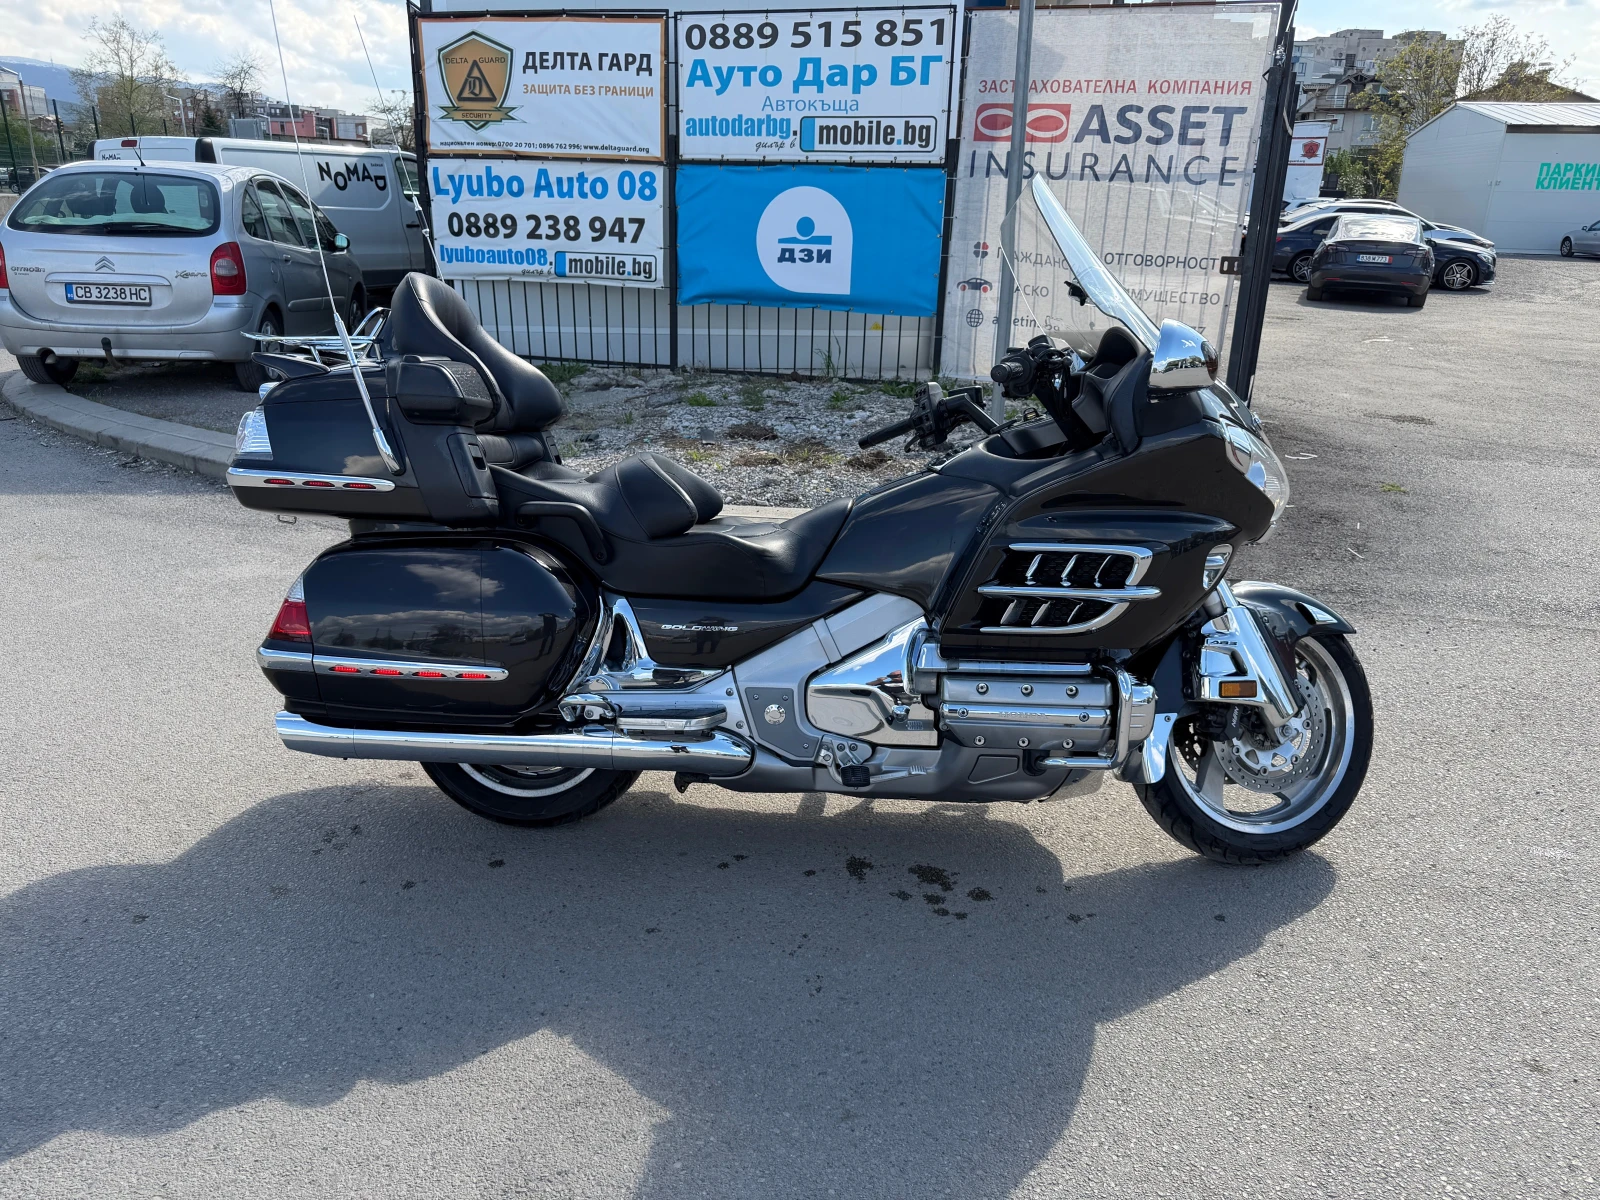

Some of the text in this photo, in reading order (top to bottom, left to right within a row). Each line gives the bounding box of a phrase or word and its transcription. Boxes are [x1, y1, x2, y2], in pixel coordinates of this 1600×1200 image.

[685, 18, 945, 50] 0889 515 851
[445, 56, 506, 65] DELTA GUARD
[522, 51, 653, 77] ДЕЛТА ГАРД
[685, 55, 943, 96] Ауто Дар БГ
[522, 83, 654, 99] ЗАЩИТА БЕЗ ГРАНИЦИ
[978, 79, 1252, 96] ЗАСТАХОВАТЕЛНА КОМПАНИЯ
[761, 95, 859, 114] Автокъща
[818, 120, 932, 149] mobile.bg
[1073, 104, 1248, 147] ASSET
[583, 144, 650, 153] www.deltaguard.org
[316, 161, 387, 192] NOMAD
[969, 149, 1240, 187] INSURANCE
[432, 165, 657, 205] Lyubo Auto 08
[447, 211, 646, 244] 0889 238 947
[777, 247, 832, 264] ДЗИ
[1103, 252, 1220, 270] ОТГОВОРНОСТ
[568, 255, 653, 279] mobile.bg
[75, 286, 93, 299] CB
[95, 287, 127, 300] 3238
[129, 288, 147, 301] HC
[1013, 283, 1050, 298] АСКО
[1126, 288, 1221, 306] МУЩЕСТВО
